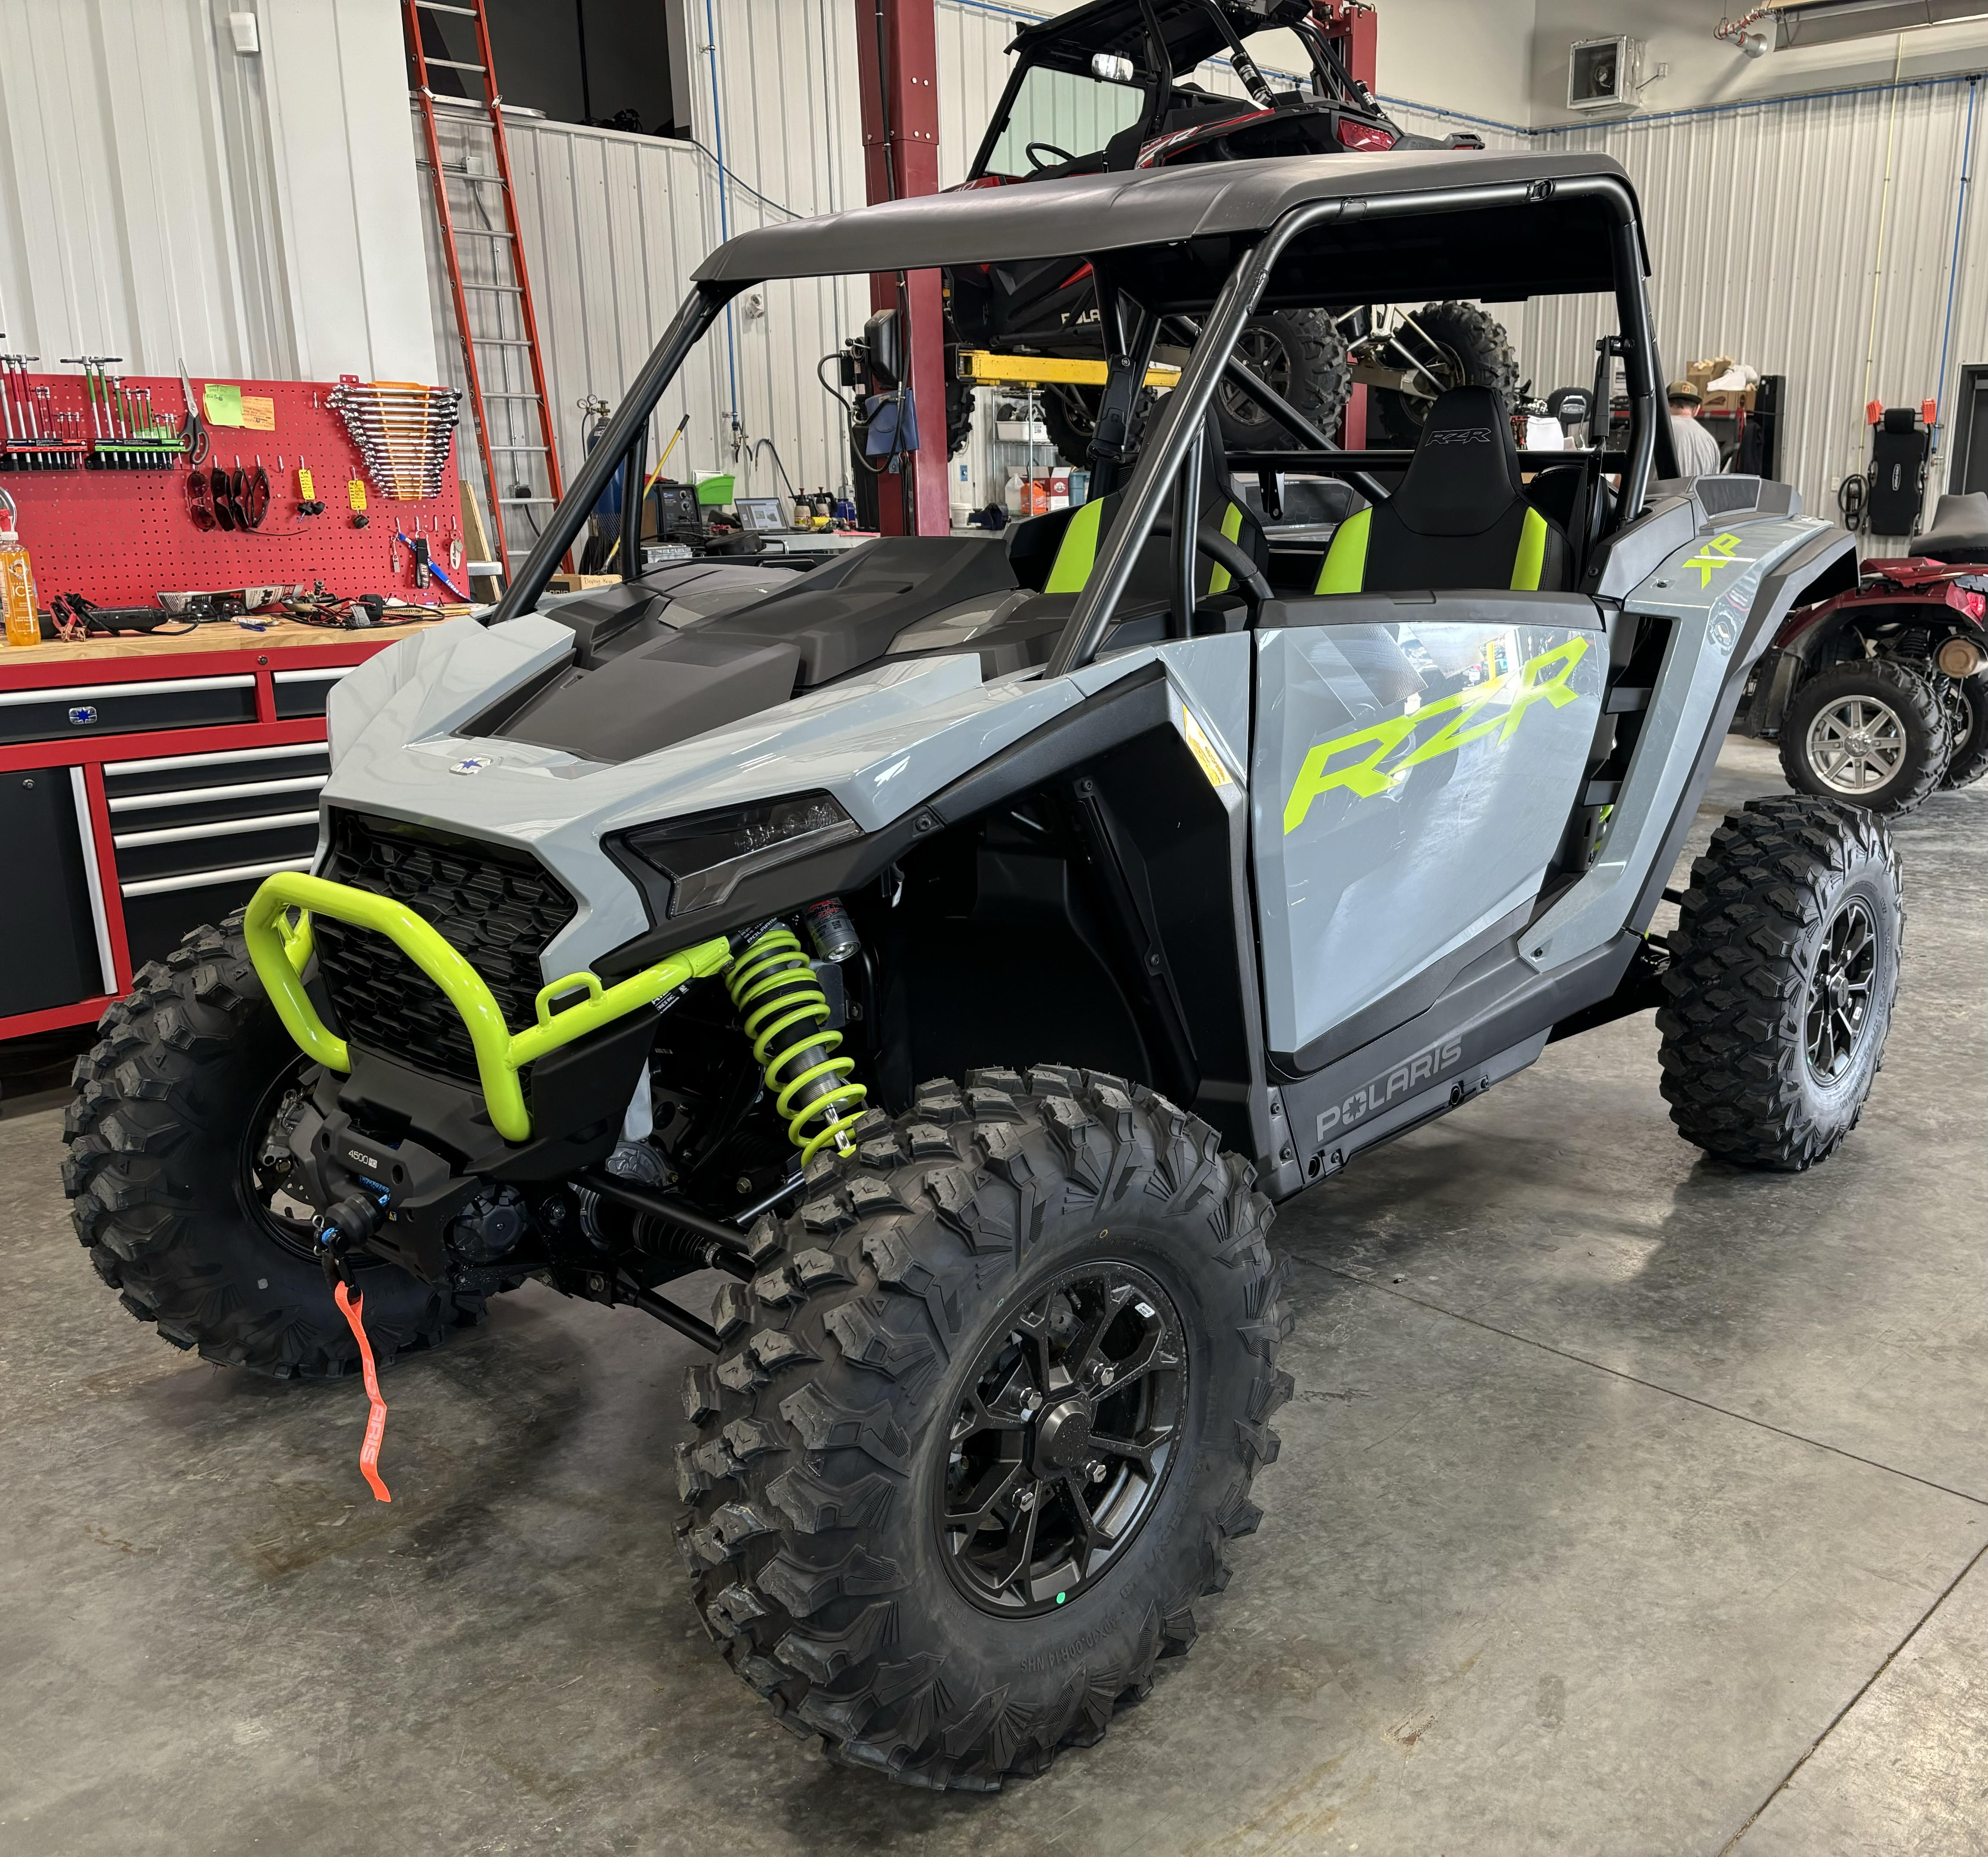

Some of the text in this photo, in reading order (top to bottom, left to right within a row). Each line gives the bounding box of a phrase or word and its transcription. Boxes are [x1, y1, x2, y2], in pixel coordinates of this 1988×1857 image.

[1424, 428, 1492, 447] RZR
[1682, 532, 1742, 590] XP
[12, 585, 34, 597] ICE
[1284, 635, 1589, 836] RZR
[1316, 1036, 1462, 1143] POLARIS
[348, 1150, 368, 1164] 4500
[1020, 1655, 1045, 1674] NHS
